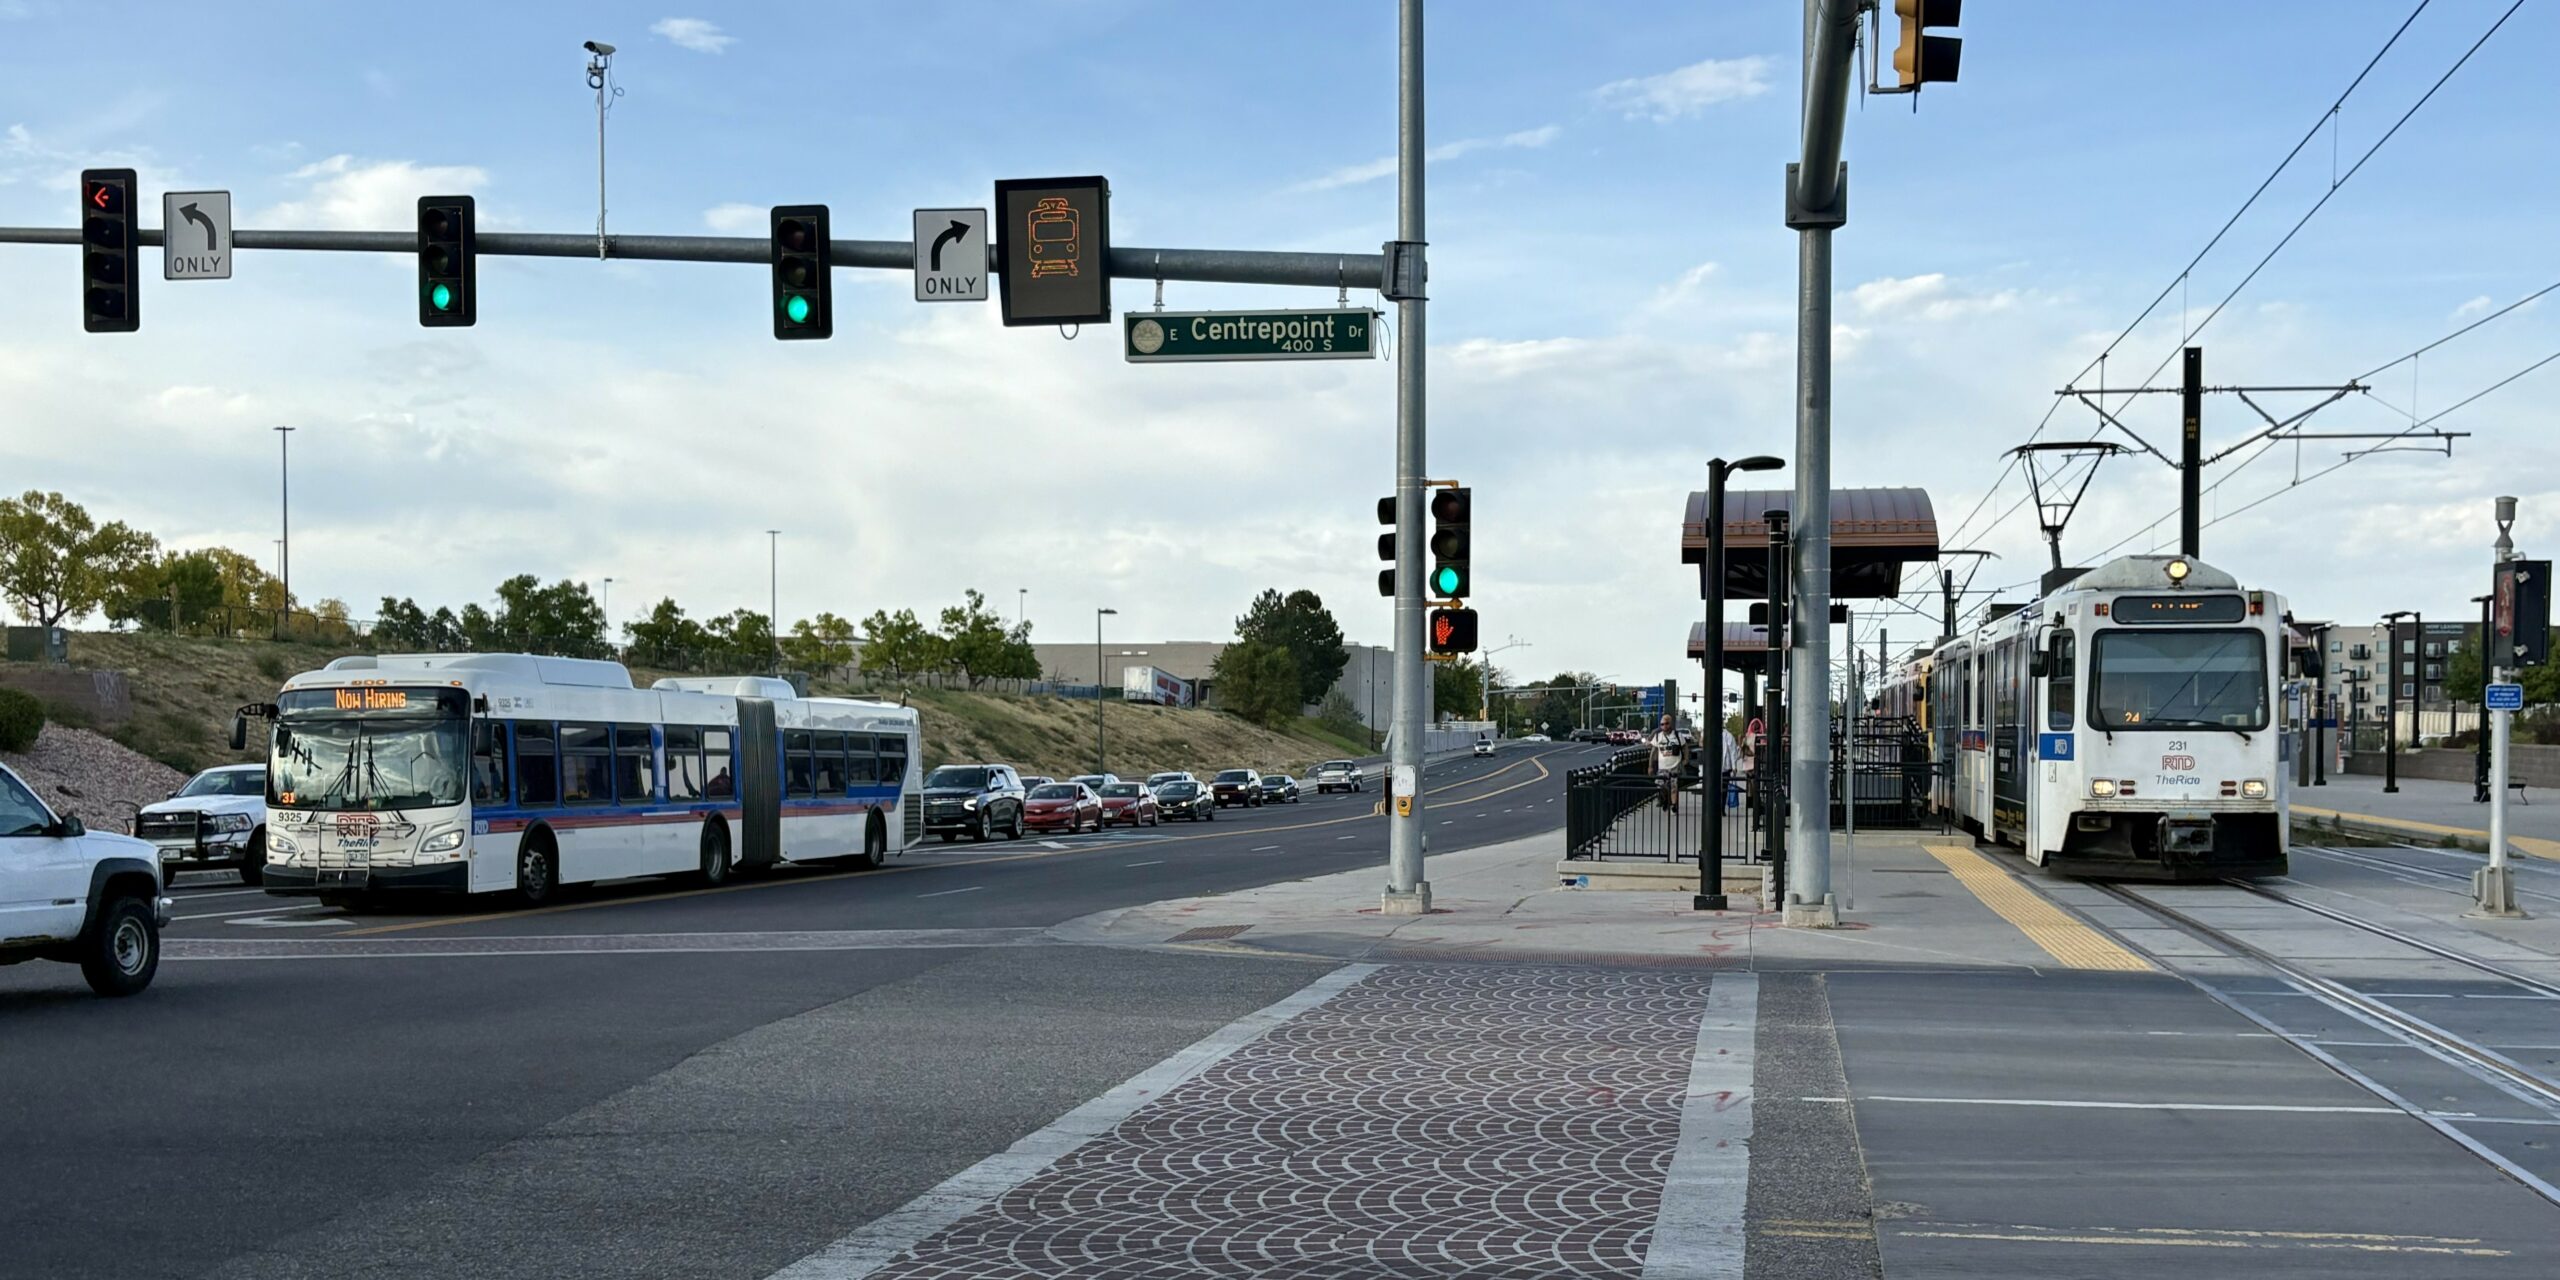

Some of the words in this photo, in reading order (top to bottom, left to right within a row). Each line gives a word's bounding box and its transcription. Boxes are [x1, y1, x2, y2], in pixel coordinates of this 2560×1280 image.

[174, 256, 222, 273] ONLY
[925, 277, 977, 295] ONLY
[1170, 328, 1178, 341] E
[1191, 315, 1335, 344] Centrepoint
[1349, 325, 1364, 338] Dr
[1281, 340, 1314, 352] 400
[1323, 340, 1333, 351] S
[2168, 741, 2188, 751] 231
[2162, 755, 2196, 771] RTD
[281, 792, 296, 804] 31
[278, 812, 302, 823] 9325
